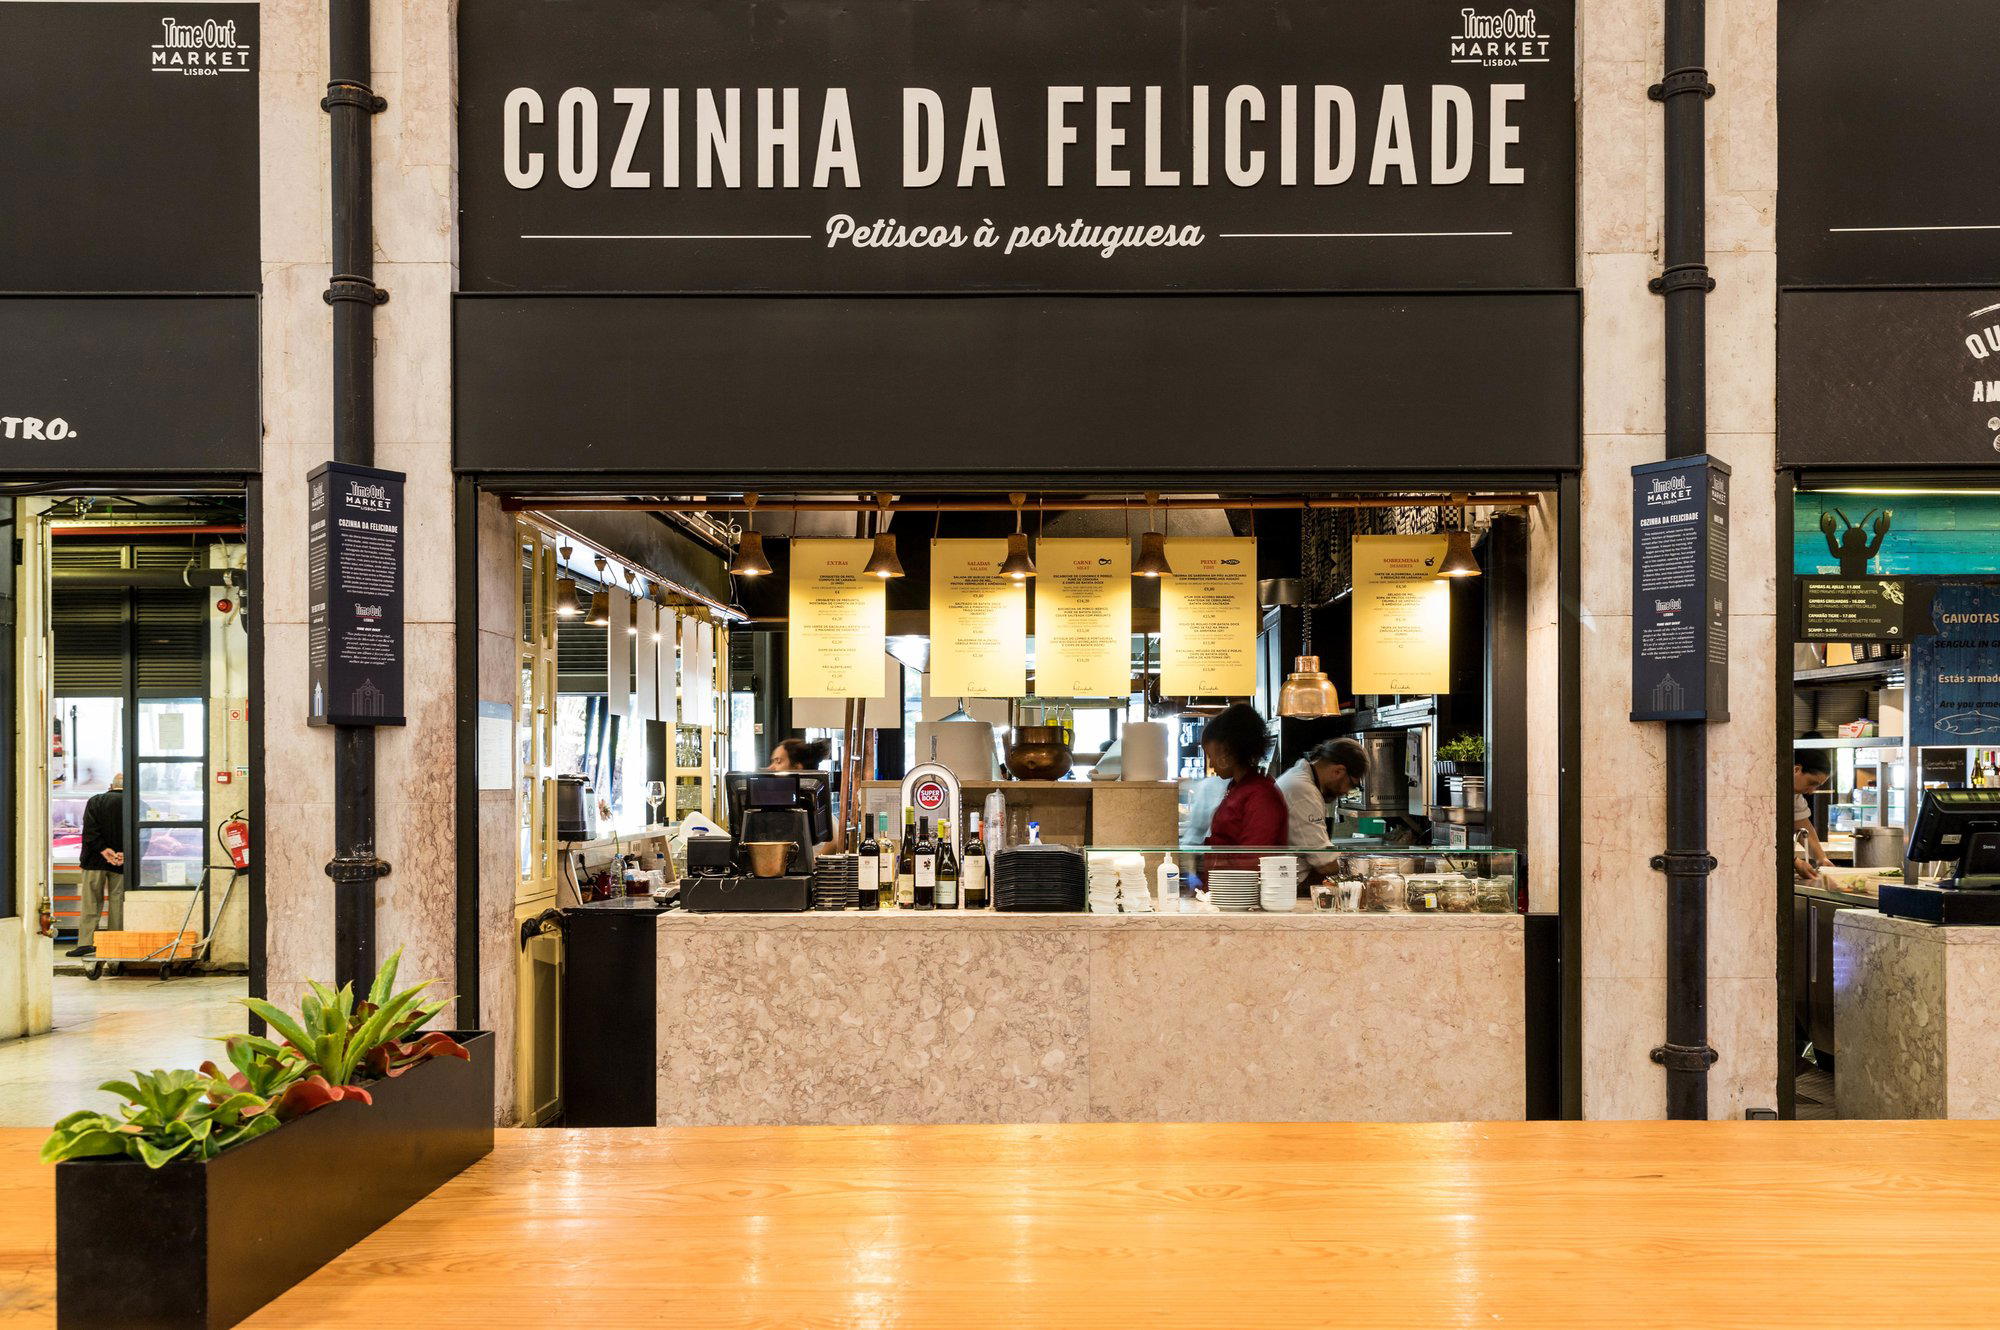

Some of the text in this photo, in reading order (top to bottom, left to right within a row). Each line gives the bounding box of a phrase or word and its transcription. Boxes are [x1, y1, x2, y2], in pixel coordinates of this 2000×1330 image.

[1461, 8, 1536, 39] Time Out
[162, 17, 236, 49] Time Out
[1451, 42, 1549, 56] MARKET
[152, 51, 249, 66] MARKET
[1483, 59, 1518, 67] LISBOA
[184, 68, 218, 76] LISBOA
[503, 84, 1525, 189] COZINHA DA FELICIDADE
[826, 213, 1205, 259] Petiscos à portuguesa
[0, 417, 77, 441] TRO.
[346, 496, 391, 508] MARKET
[1647, 489, 1692, 502] MARKET
[338, 518, 360, 529] COZINHA
[362, 522, 369, 530] DA
[370, 522, 398, 534] FELICIDADE
[1640, 512, 1699, 527] COZINHA DA FELICIDADE
[1942, 614, 1999, 623] GAIVOTAS
[1934, 640, 1976, 648] SEAGULL
[1978, 640, 1988, 648] IN
[1938, 674, 1965, 683] Estás
